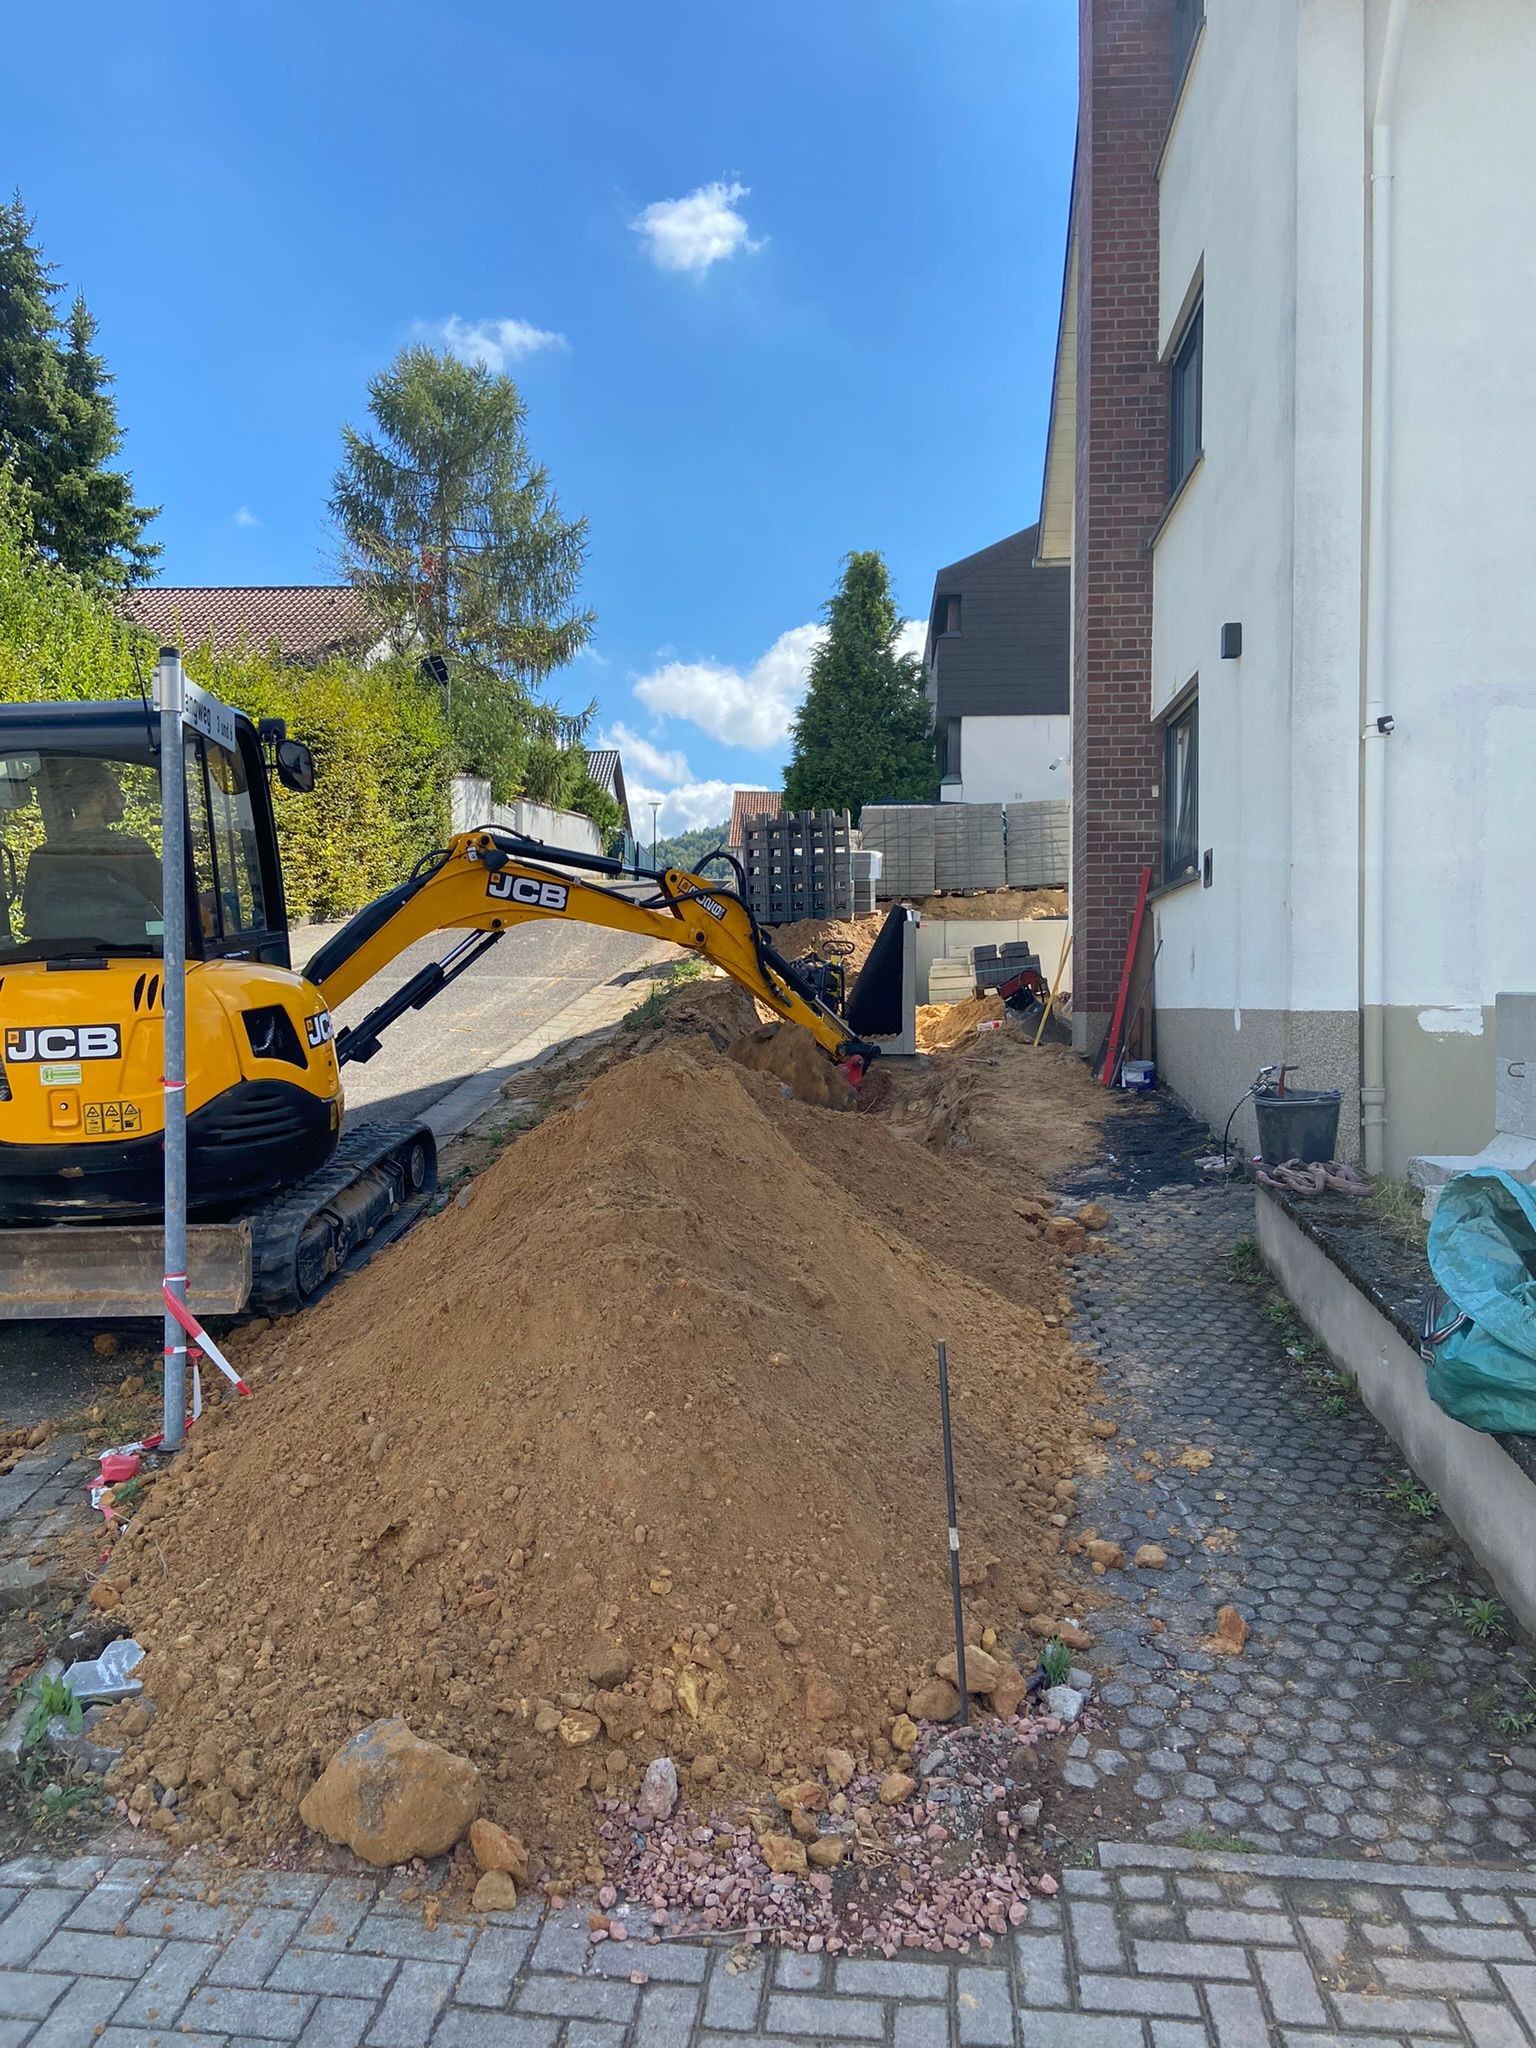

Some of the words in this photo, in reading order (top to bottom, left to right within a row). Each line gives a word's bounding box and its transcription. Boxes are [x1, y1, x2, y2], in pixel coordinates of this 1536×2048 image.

[184, 692, 212, 735] angweg
[488, 875, 567, 909] JCB
[8, 1027, 119, 1061] JCB
